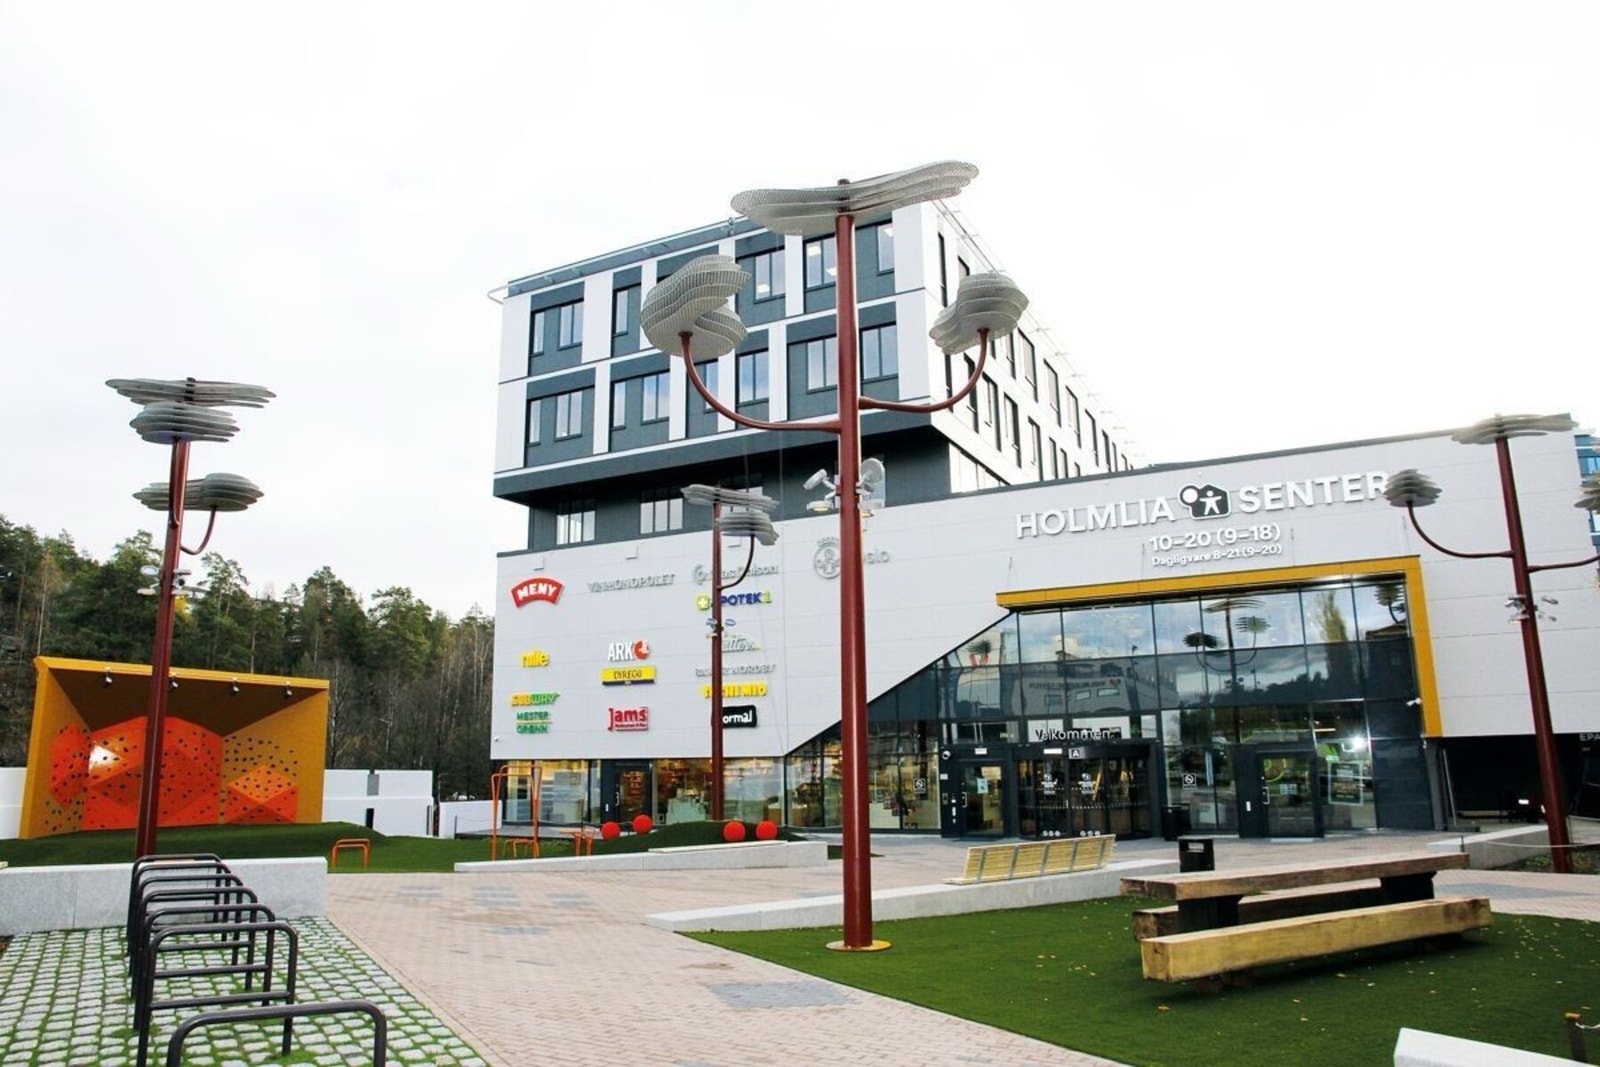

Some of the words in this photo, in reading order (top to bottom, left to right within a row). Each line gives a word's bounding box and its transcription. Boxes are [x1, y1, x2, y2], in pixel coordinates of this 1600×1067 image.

[1015, 497, 1176, 539] HOLMLIA
[1239, 471, 1388, 514] SENTER
[1149, 530, 1212, 552] 10–20
[1217, 522, 1281, 547] (9–18)
[1151, 552, 1211, 568] Dagligvare
[516, 583, 557, 601] MENY
[711, 592, 762, 607] POTEK
[522, 649, 549, 668] nille
[608, 641, 635, 662] ARK
[511, 692, 560, 707] SUBWAY
[516, 711, 549, 721] MESTER
[722, 710, 753, 724] ormal
[1034, 727, 1110, 741] Velkommen
[1072, 750, 1080, 758] A
